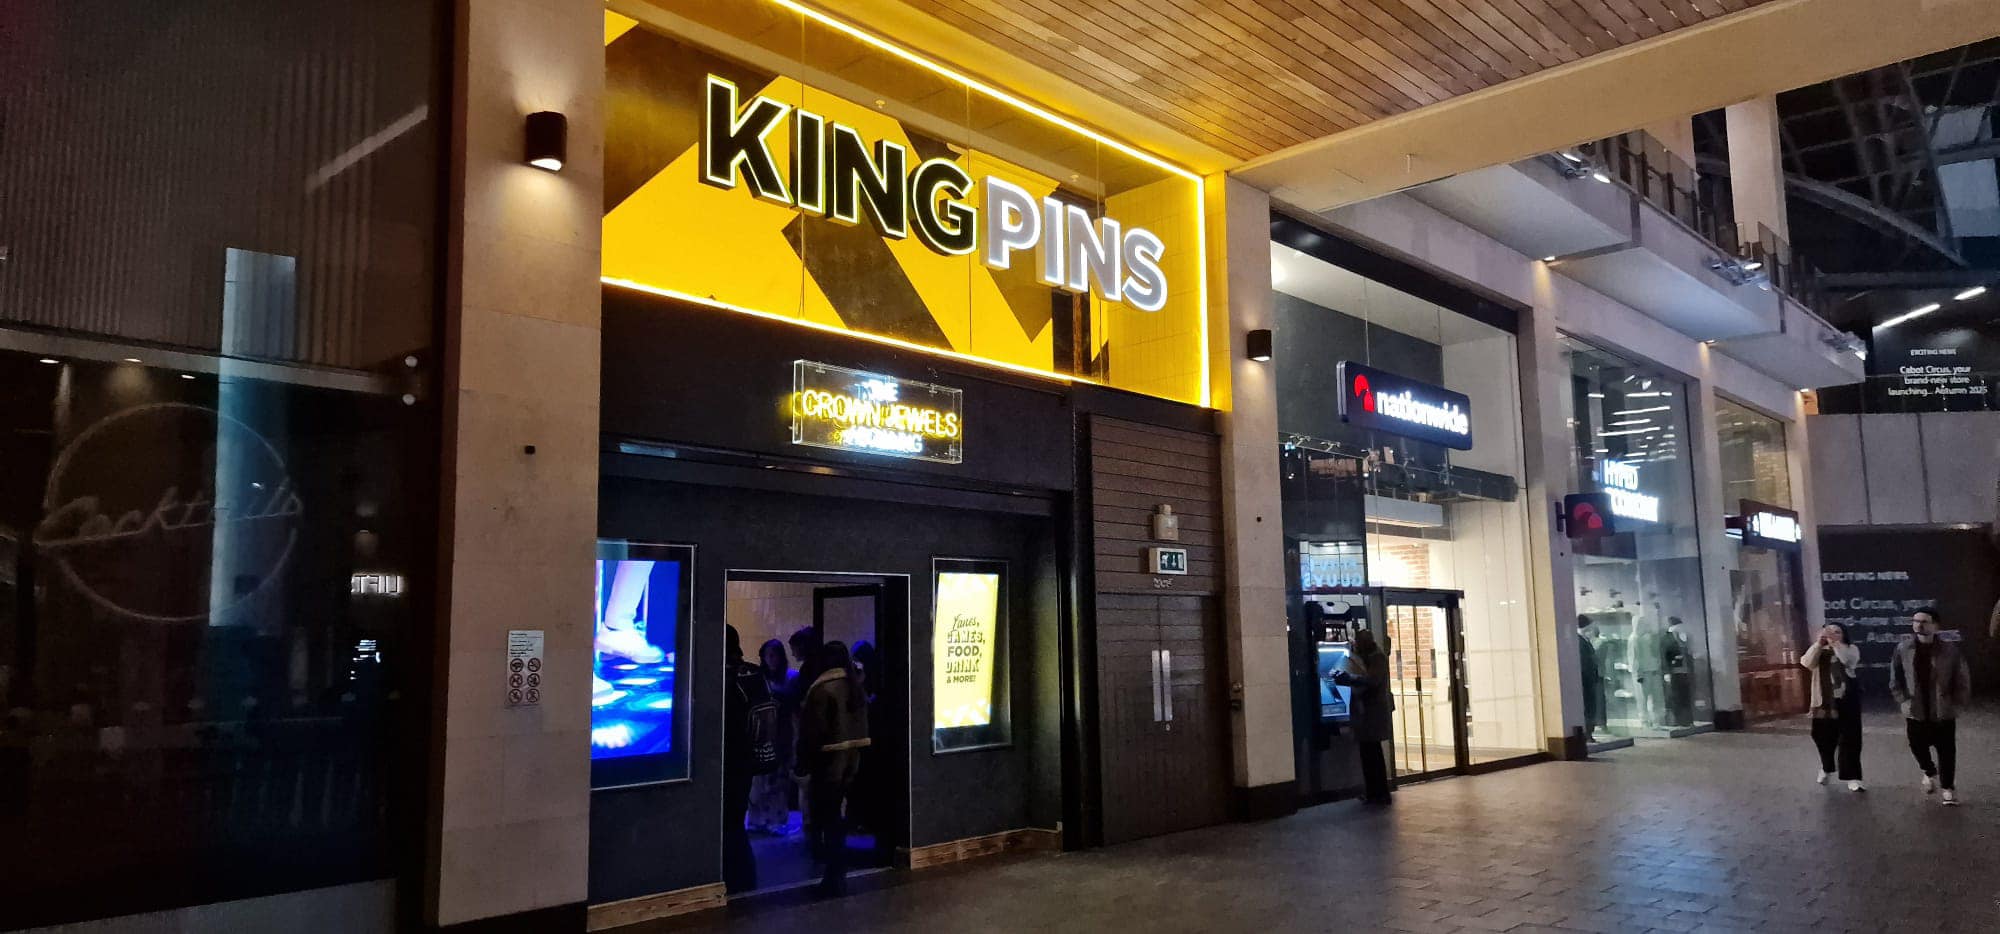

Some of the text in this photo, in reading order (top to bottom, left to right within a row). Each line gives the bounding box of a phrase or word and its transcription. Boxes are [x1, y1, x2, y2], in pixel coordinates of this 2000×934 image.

[802, 389, 958, 438] CROWN JEWELS
[1376, 390, 1469, 436] nationwide
[948, 645, 982, 657] FOOD,
